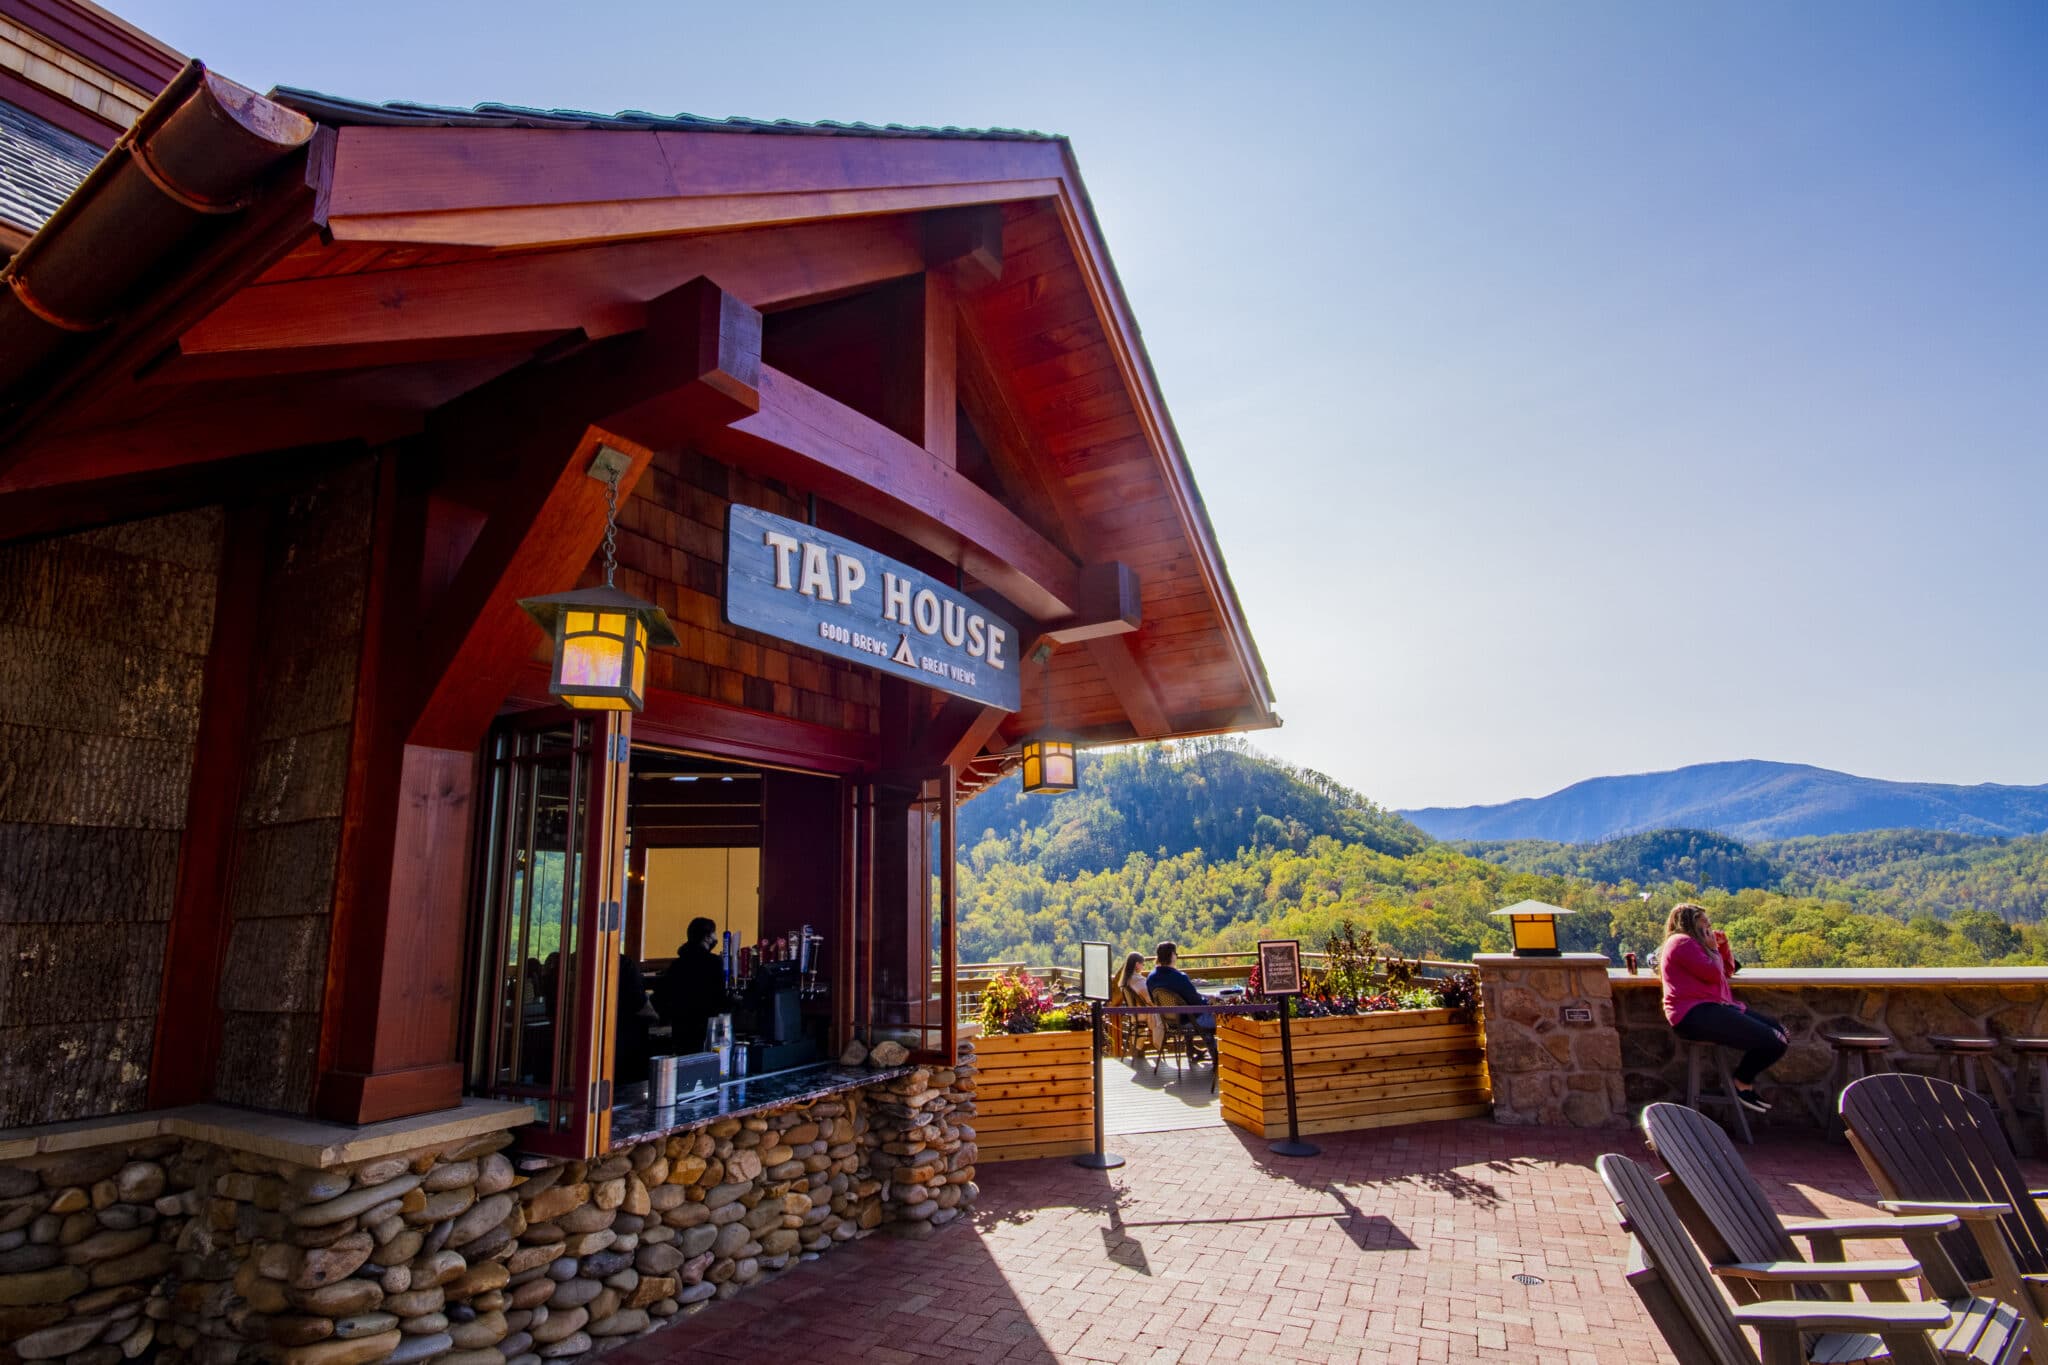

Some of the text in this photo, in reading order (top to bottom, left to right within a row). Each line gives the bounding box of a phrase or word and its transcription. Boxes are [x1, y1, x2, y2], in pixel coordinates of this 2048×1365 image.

[765, 531, 1005, 669] TAP HOUSE
[820, 622, 888, 656] GOOD BREWS
[920, 656, 976, 685] GREAT VIEWS
